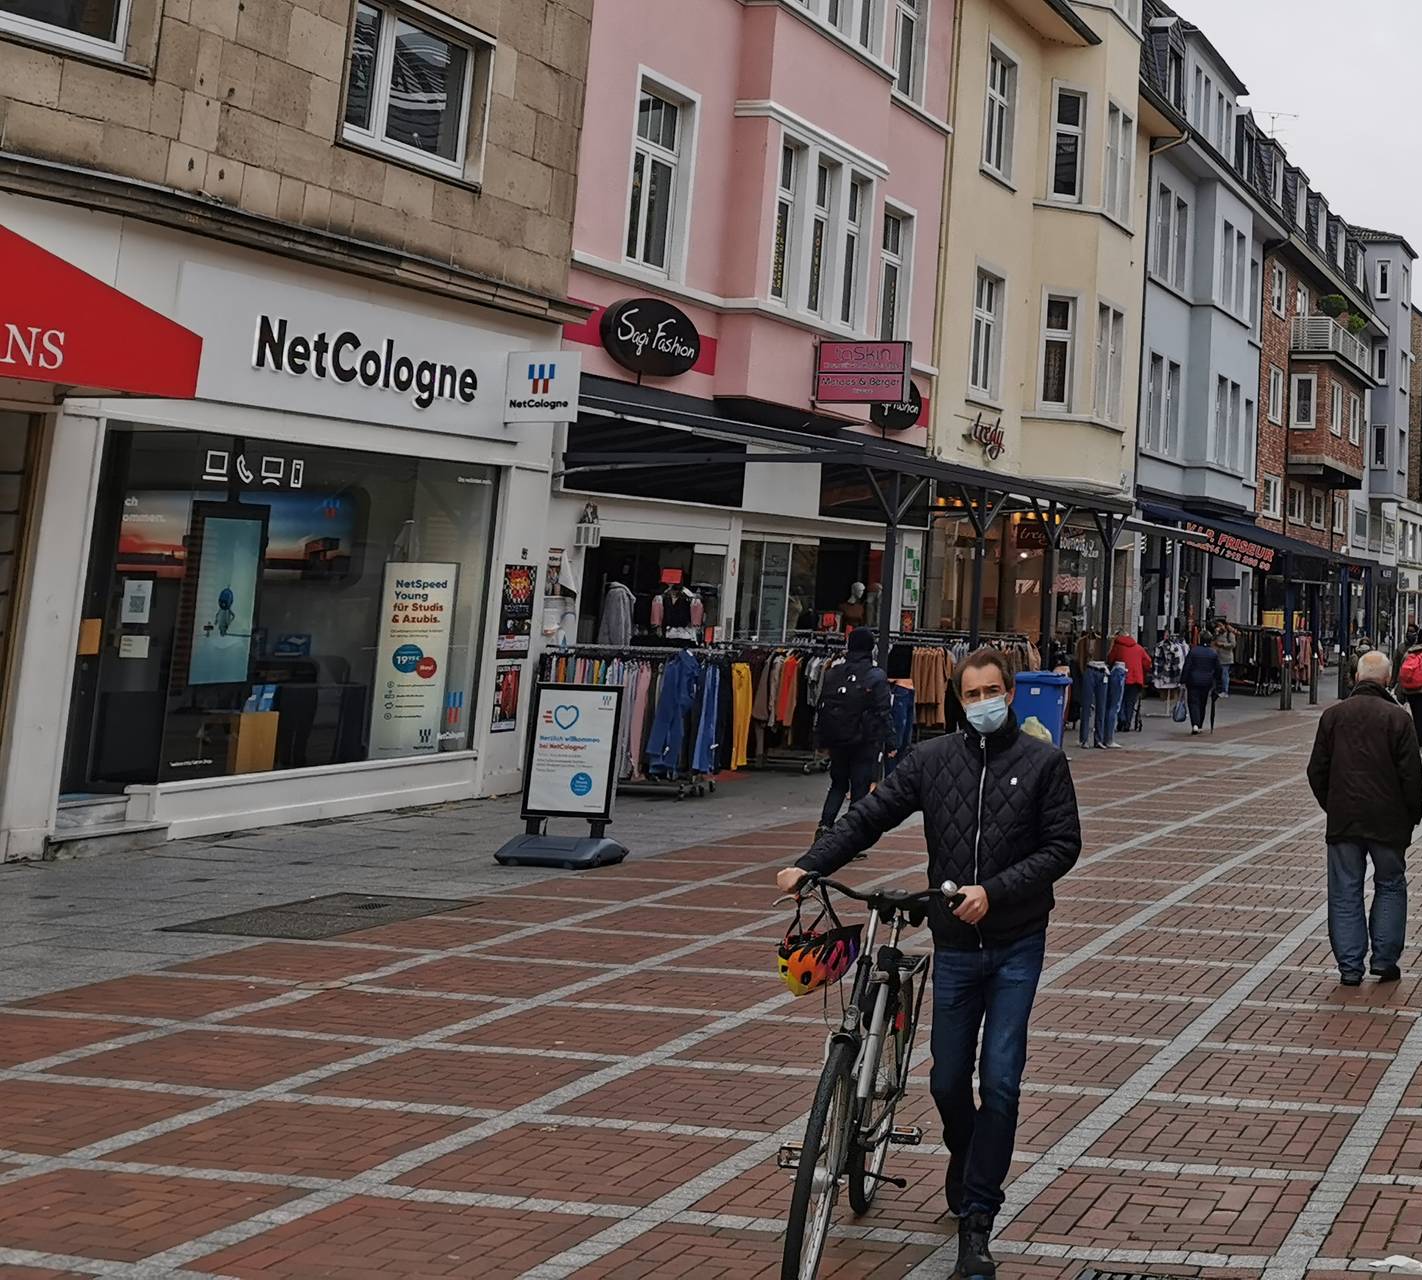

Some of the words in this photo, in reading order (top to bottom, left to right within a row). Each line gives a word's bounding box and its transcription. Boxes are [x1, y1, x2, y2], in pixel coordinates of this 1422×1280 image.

[618, 308, 650, 356] Sagi
[652, 318, 695, 359] Fashion
[0, 323, 65, 369] NS
[253, 314, 478, 409] NetCologne
[509, 399, 569, 409] NetCologne
[1218, 533, 1275, 562] FRISEUR
[395, 579, 448, 590] NetSpeed
[395, 591, 429, 602] Young
[393, 603, 408, 612] für
[411, 603, 444, 612] Studis
[402, 614, 441, 624] Azubis.
